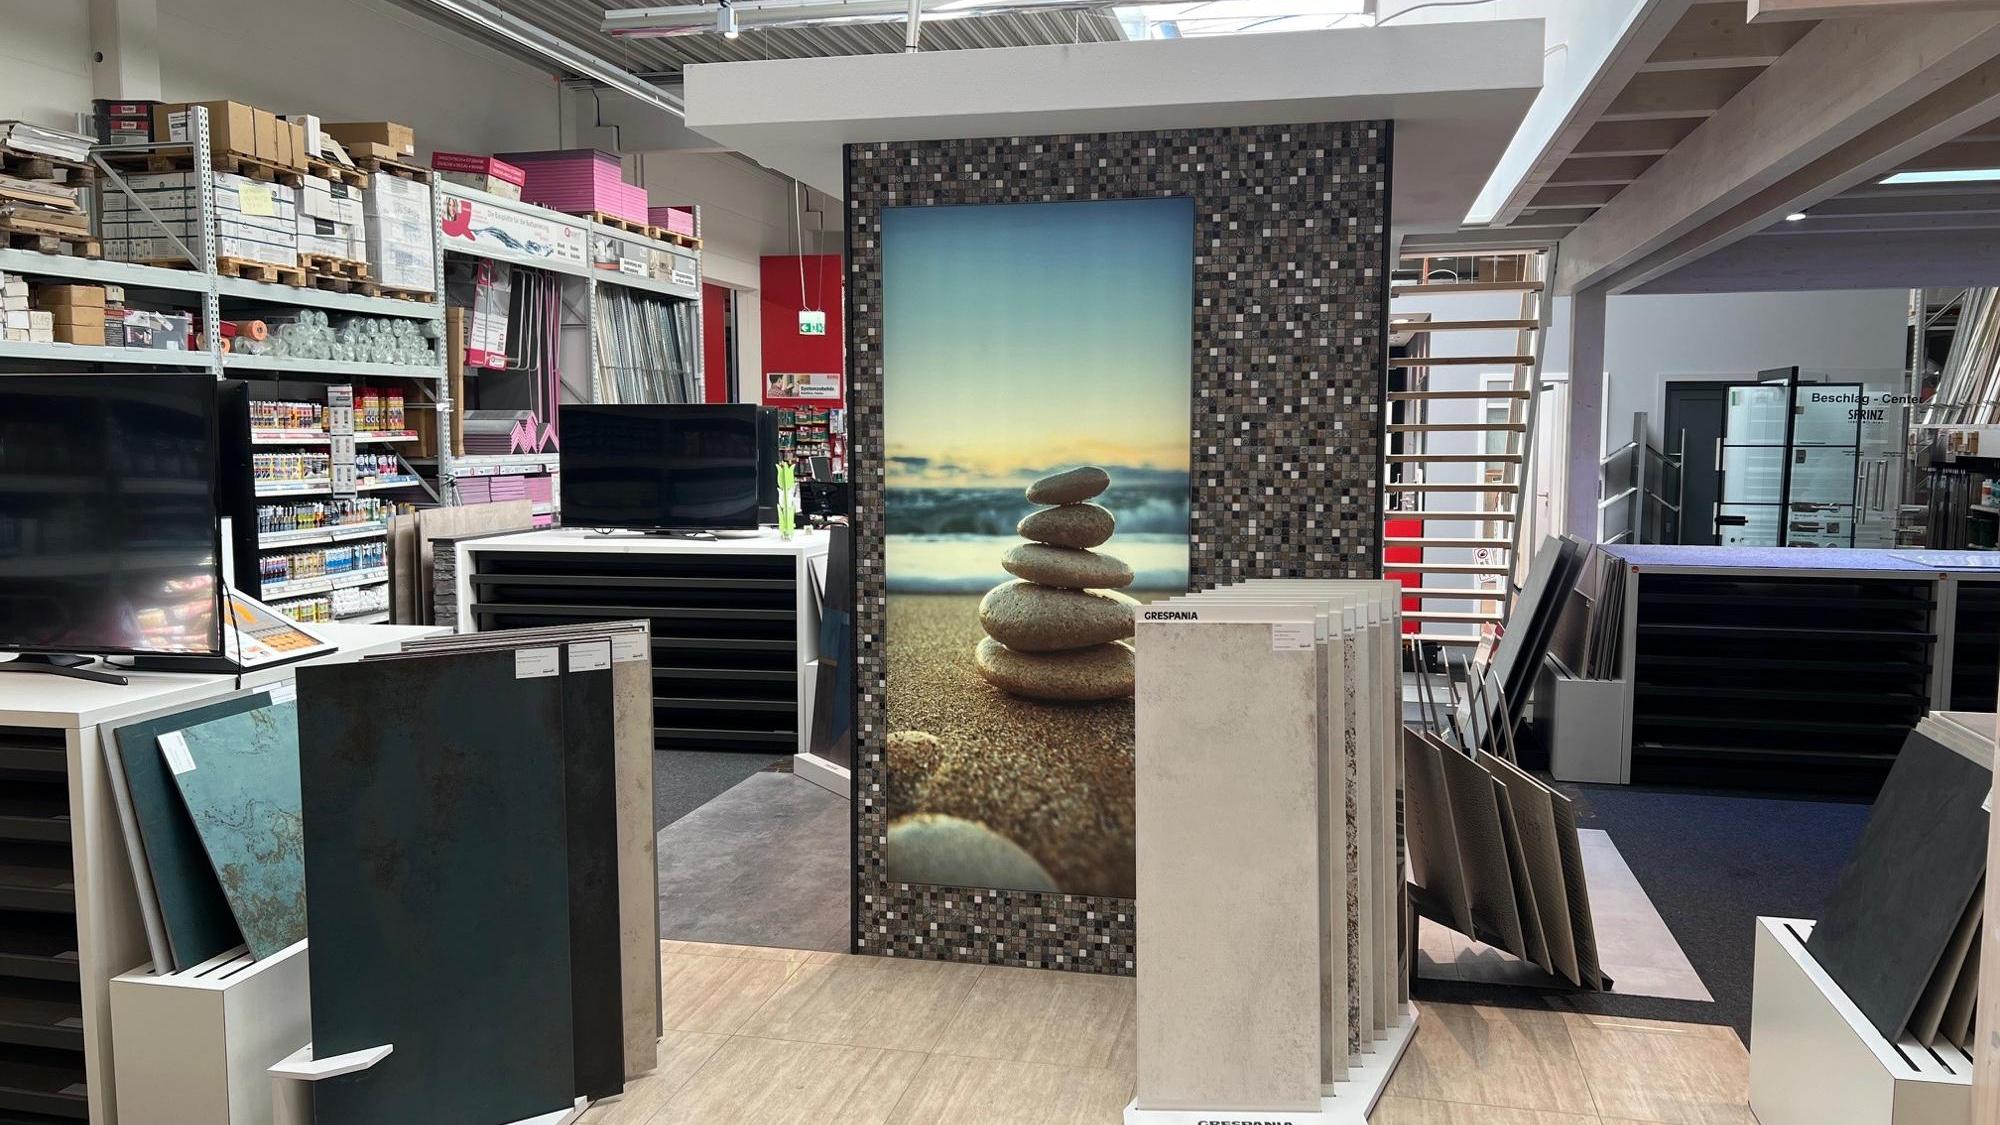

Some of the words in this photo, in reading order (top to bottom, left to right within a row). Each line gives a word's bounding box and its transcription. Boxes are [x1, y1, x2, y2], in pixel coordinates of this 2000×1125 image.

[1811, 392, 1870, 405] Beschlag
[1882, 393, 1923, 404] Center
[1848, 409, 1884, 420] SPRINZ
[1144, 611, 1198, 620] GRESPANIA
